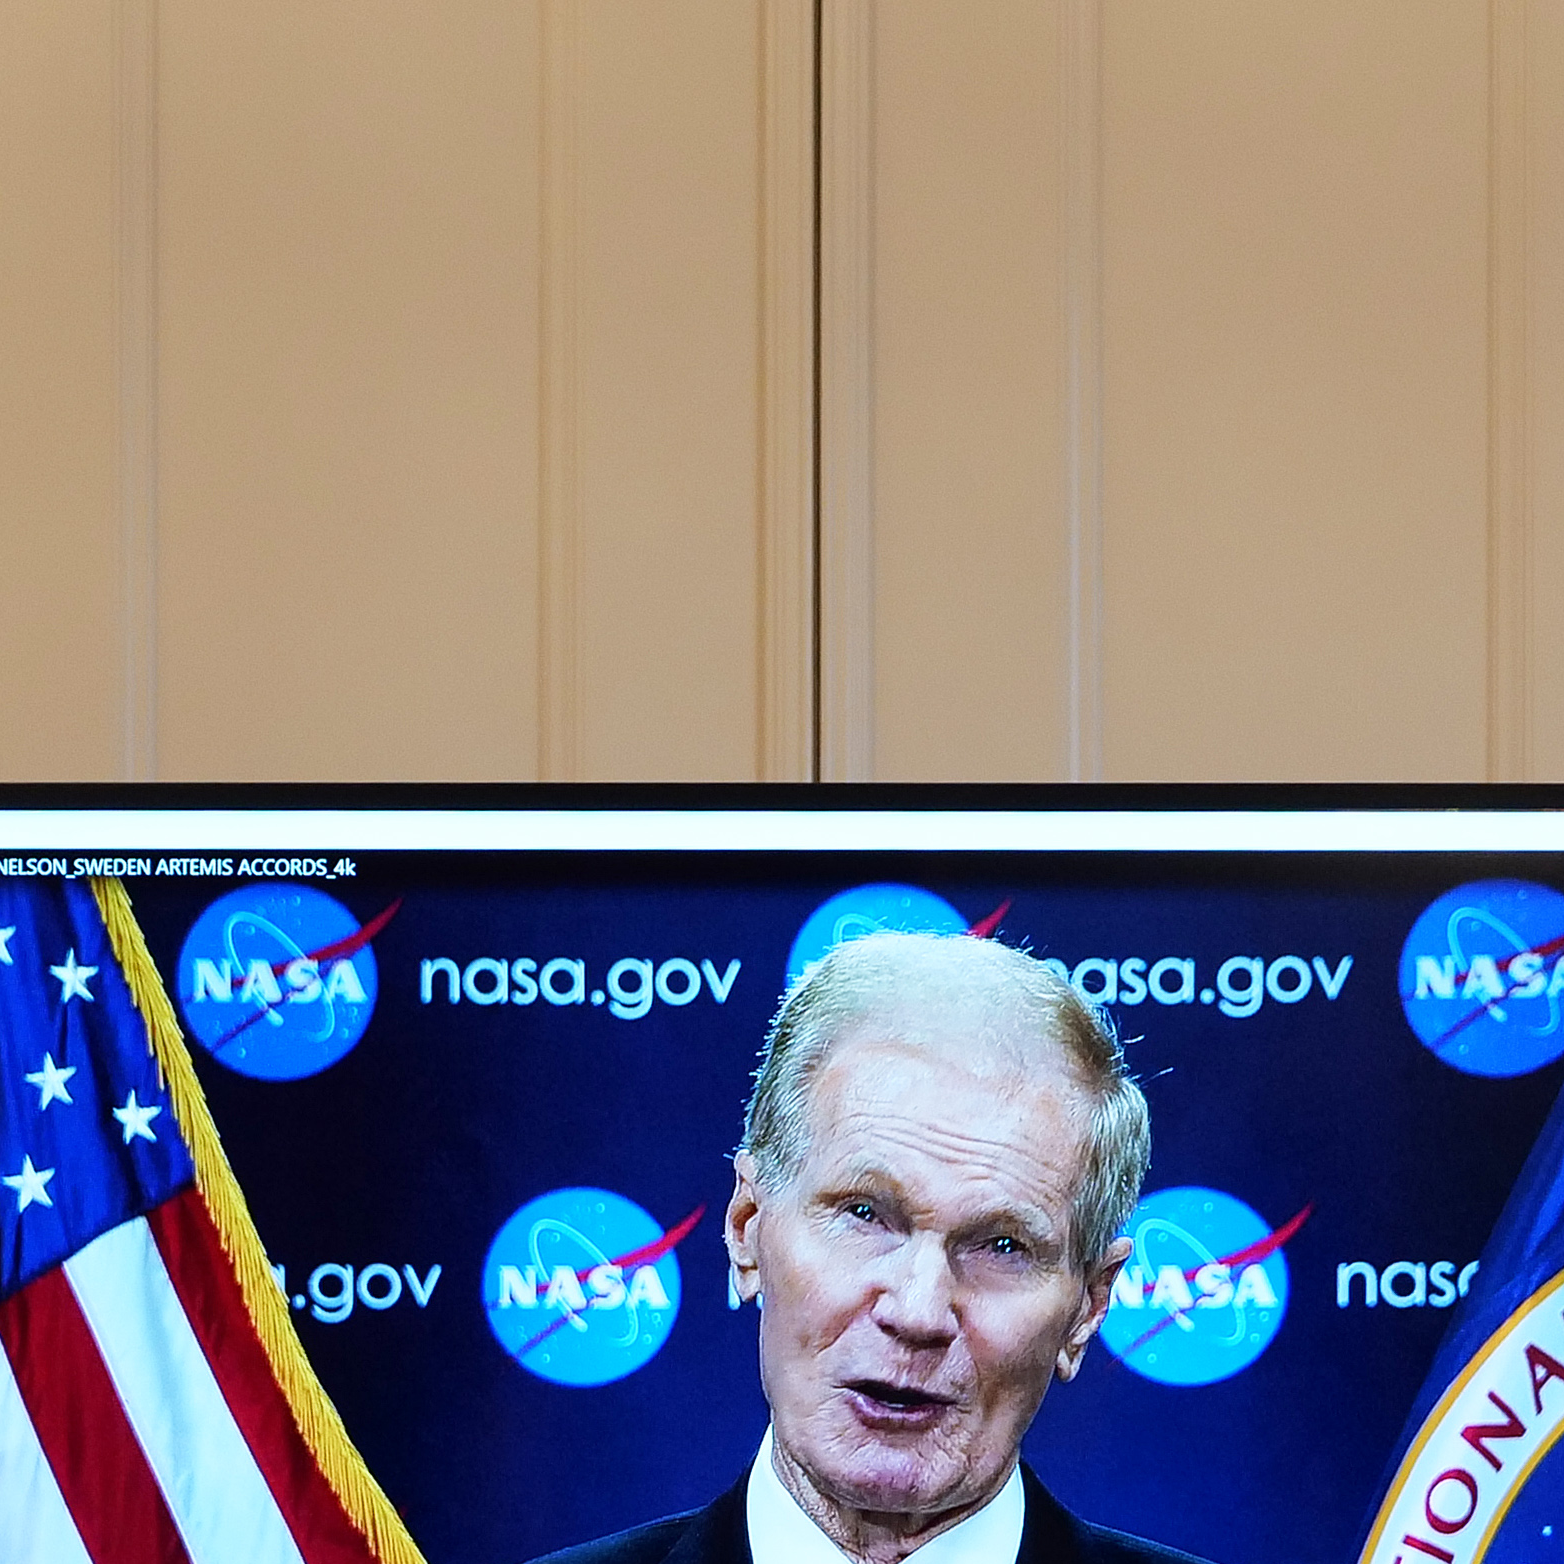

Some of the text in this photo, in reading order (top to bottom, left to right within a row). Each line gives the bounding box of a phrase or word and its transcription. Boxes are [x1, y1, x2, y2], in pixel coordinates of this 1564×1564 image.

[155, 857, 234, 877] ARTEMIS
[237, 857, 357, 880] ACCORDS_4k
[192, 957, 367, 1003] NASA
[420, 955, 742, 1021] nasa.gov
[499, 1264, 671, 1310] NASA
[1110, 1263, 1279, 1310] NASA
